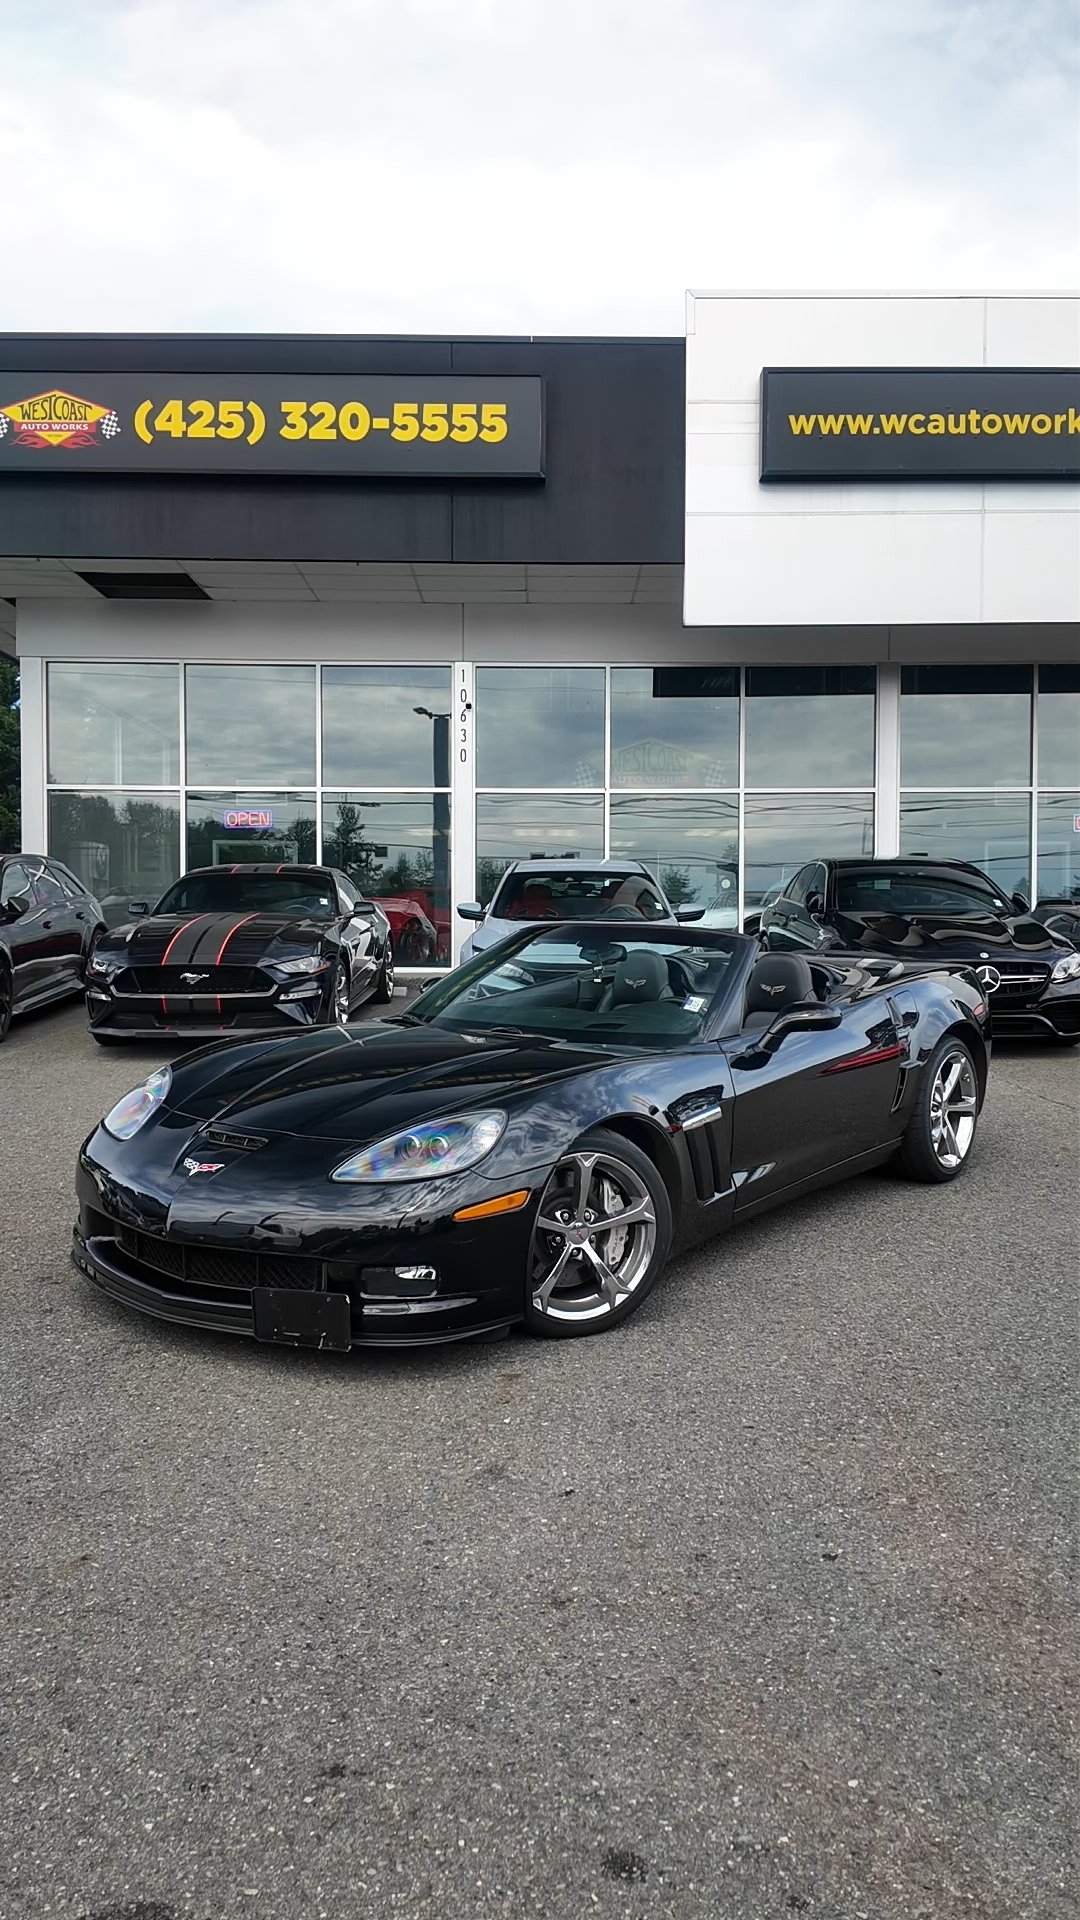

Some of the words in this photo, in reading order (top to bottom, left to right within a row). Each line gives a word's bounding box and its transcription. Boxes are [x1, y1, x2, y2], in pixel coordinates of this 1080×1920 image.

[18, 394, 92, 421] WESTCOAST
[20, 423, 49, 431] AUTO
[51, 423, 89, 431] WORKS
[134, 399, 266, 445] (425)
[279, 401, 508, 442] 320-5555
[788, 408, 1080, 435] www.wcautowork
[226, 811, 270, 826] OPEN
